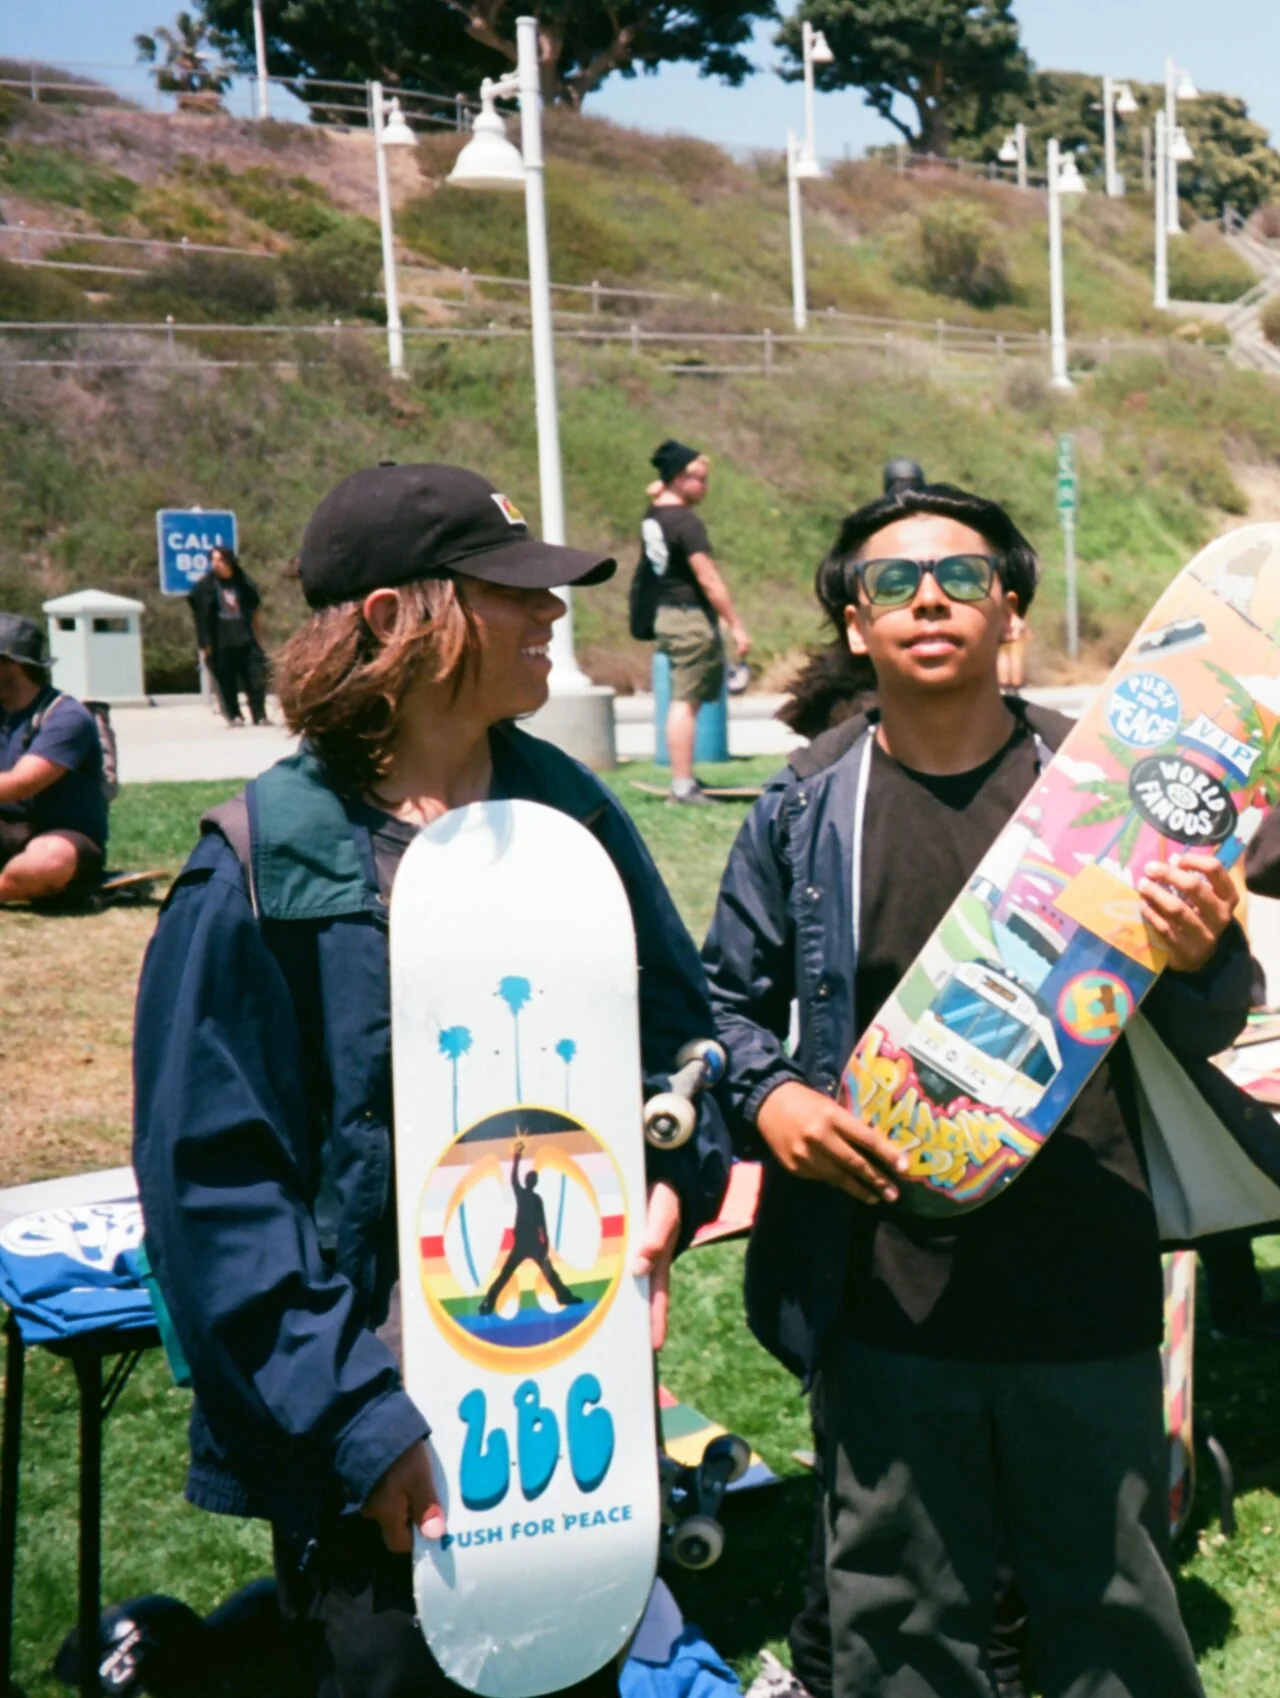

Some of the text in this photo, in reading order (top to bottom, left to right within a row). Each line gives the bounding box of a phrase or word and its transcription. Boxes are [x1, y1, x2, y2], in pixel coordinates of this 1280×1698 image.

[176, 553, 208, 571] BO
[1127, 675, 1176, 709] PUSH
[1110, 693, 1178, 744] PEACE
[1199, 722, 1252, 760] VIP
[1135, 779, 1214, 836] FAMOUS
[1159, 760, 1226, 812] WORLD
[458, 1372, 616, 1513] LBC
[440, 1504, 633, 1552] PUSH FOR PEACE
